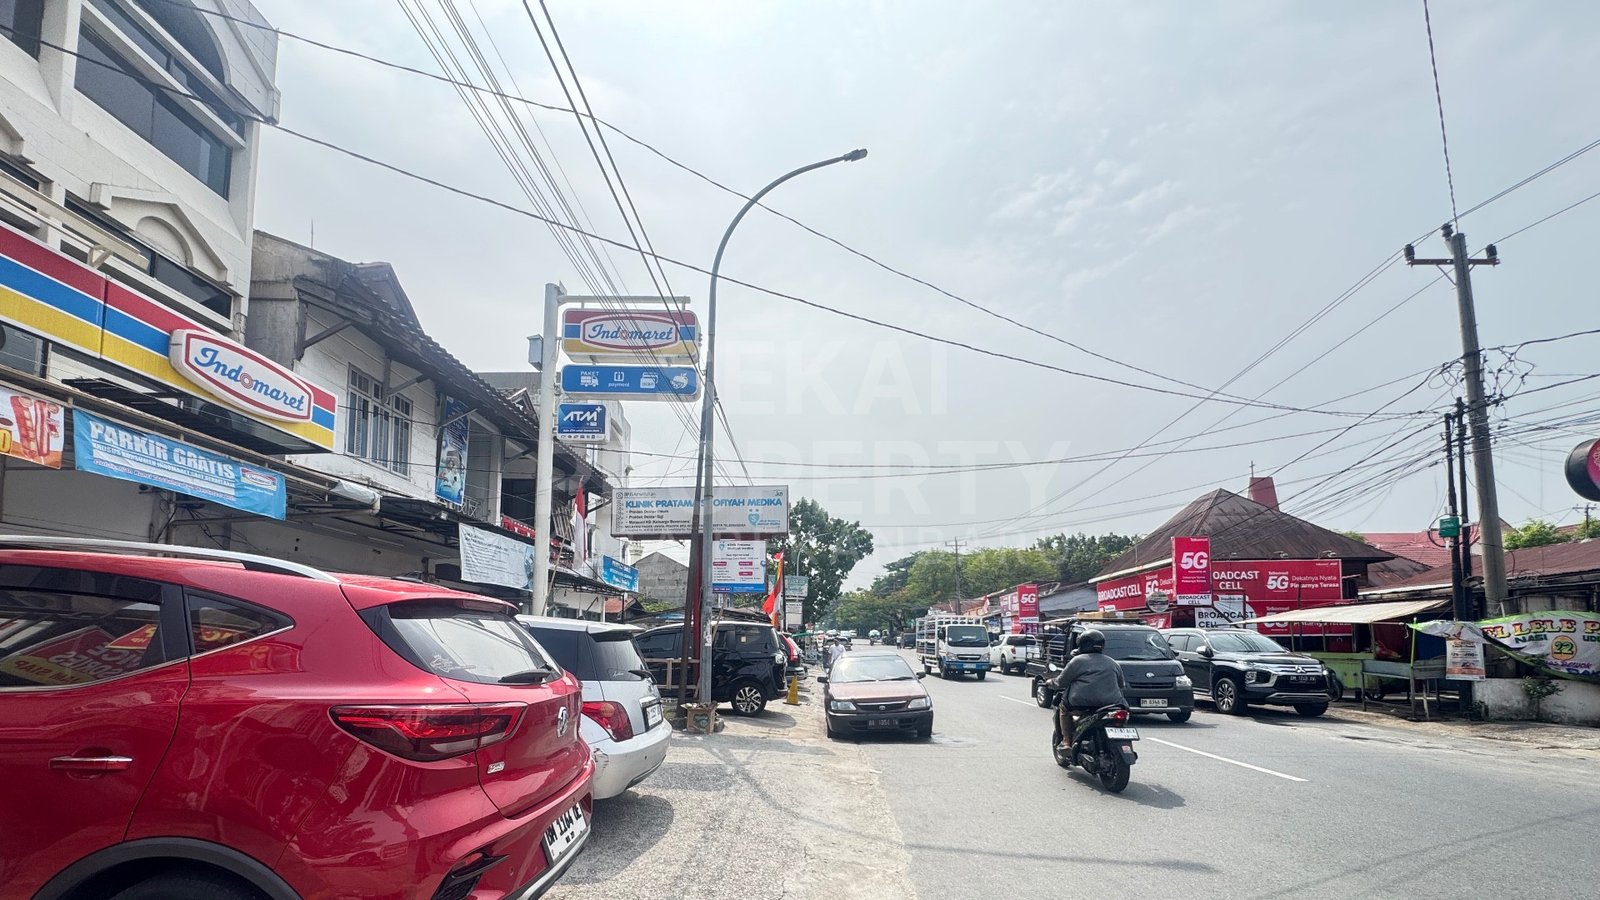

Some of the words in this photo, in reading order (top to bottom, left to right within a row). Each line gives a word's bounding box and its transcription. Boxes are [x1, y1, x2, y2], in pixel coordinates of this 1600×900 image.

[588, 323, 673, 341] Indomaret
[195, 347, 305, 412] Indomaret
[89, 420, 169, 463] PARKIR
[173, 447, 236, 480] GRATIS
[625, 500, 654, 509] KLINIK
[655, 499, 694, 508] PRATAM
[700, 498, 745, 507] SOFIYAH
[747, 498, 783, 507] MEDIKA
[1180, 551, 1209, 570] 5G
[1212, 571, 1259, 580] OADCAST
[1265, 576, 1289, 590] 5G
[1098, 586, 1128, 602] BROADCAST
[1127, 583, 1142, 597] CELL
[1219, 581, 1243, 590] CELL
[1021, 593, 1036, 604] 5G
[1512, 619, 1577, 637] LELE
[1515, 634, 1548, 644] NASI
[1554, 640, 1574, 655] 22
